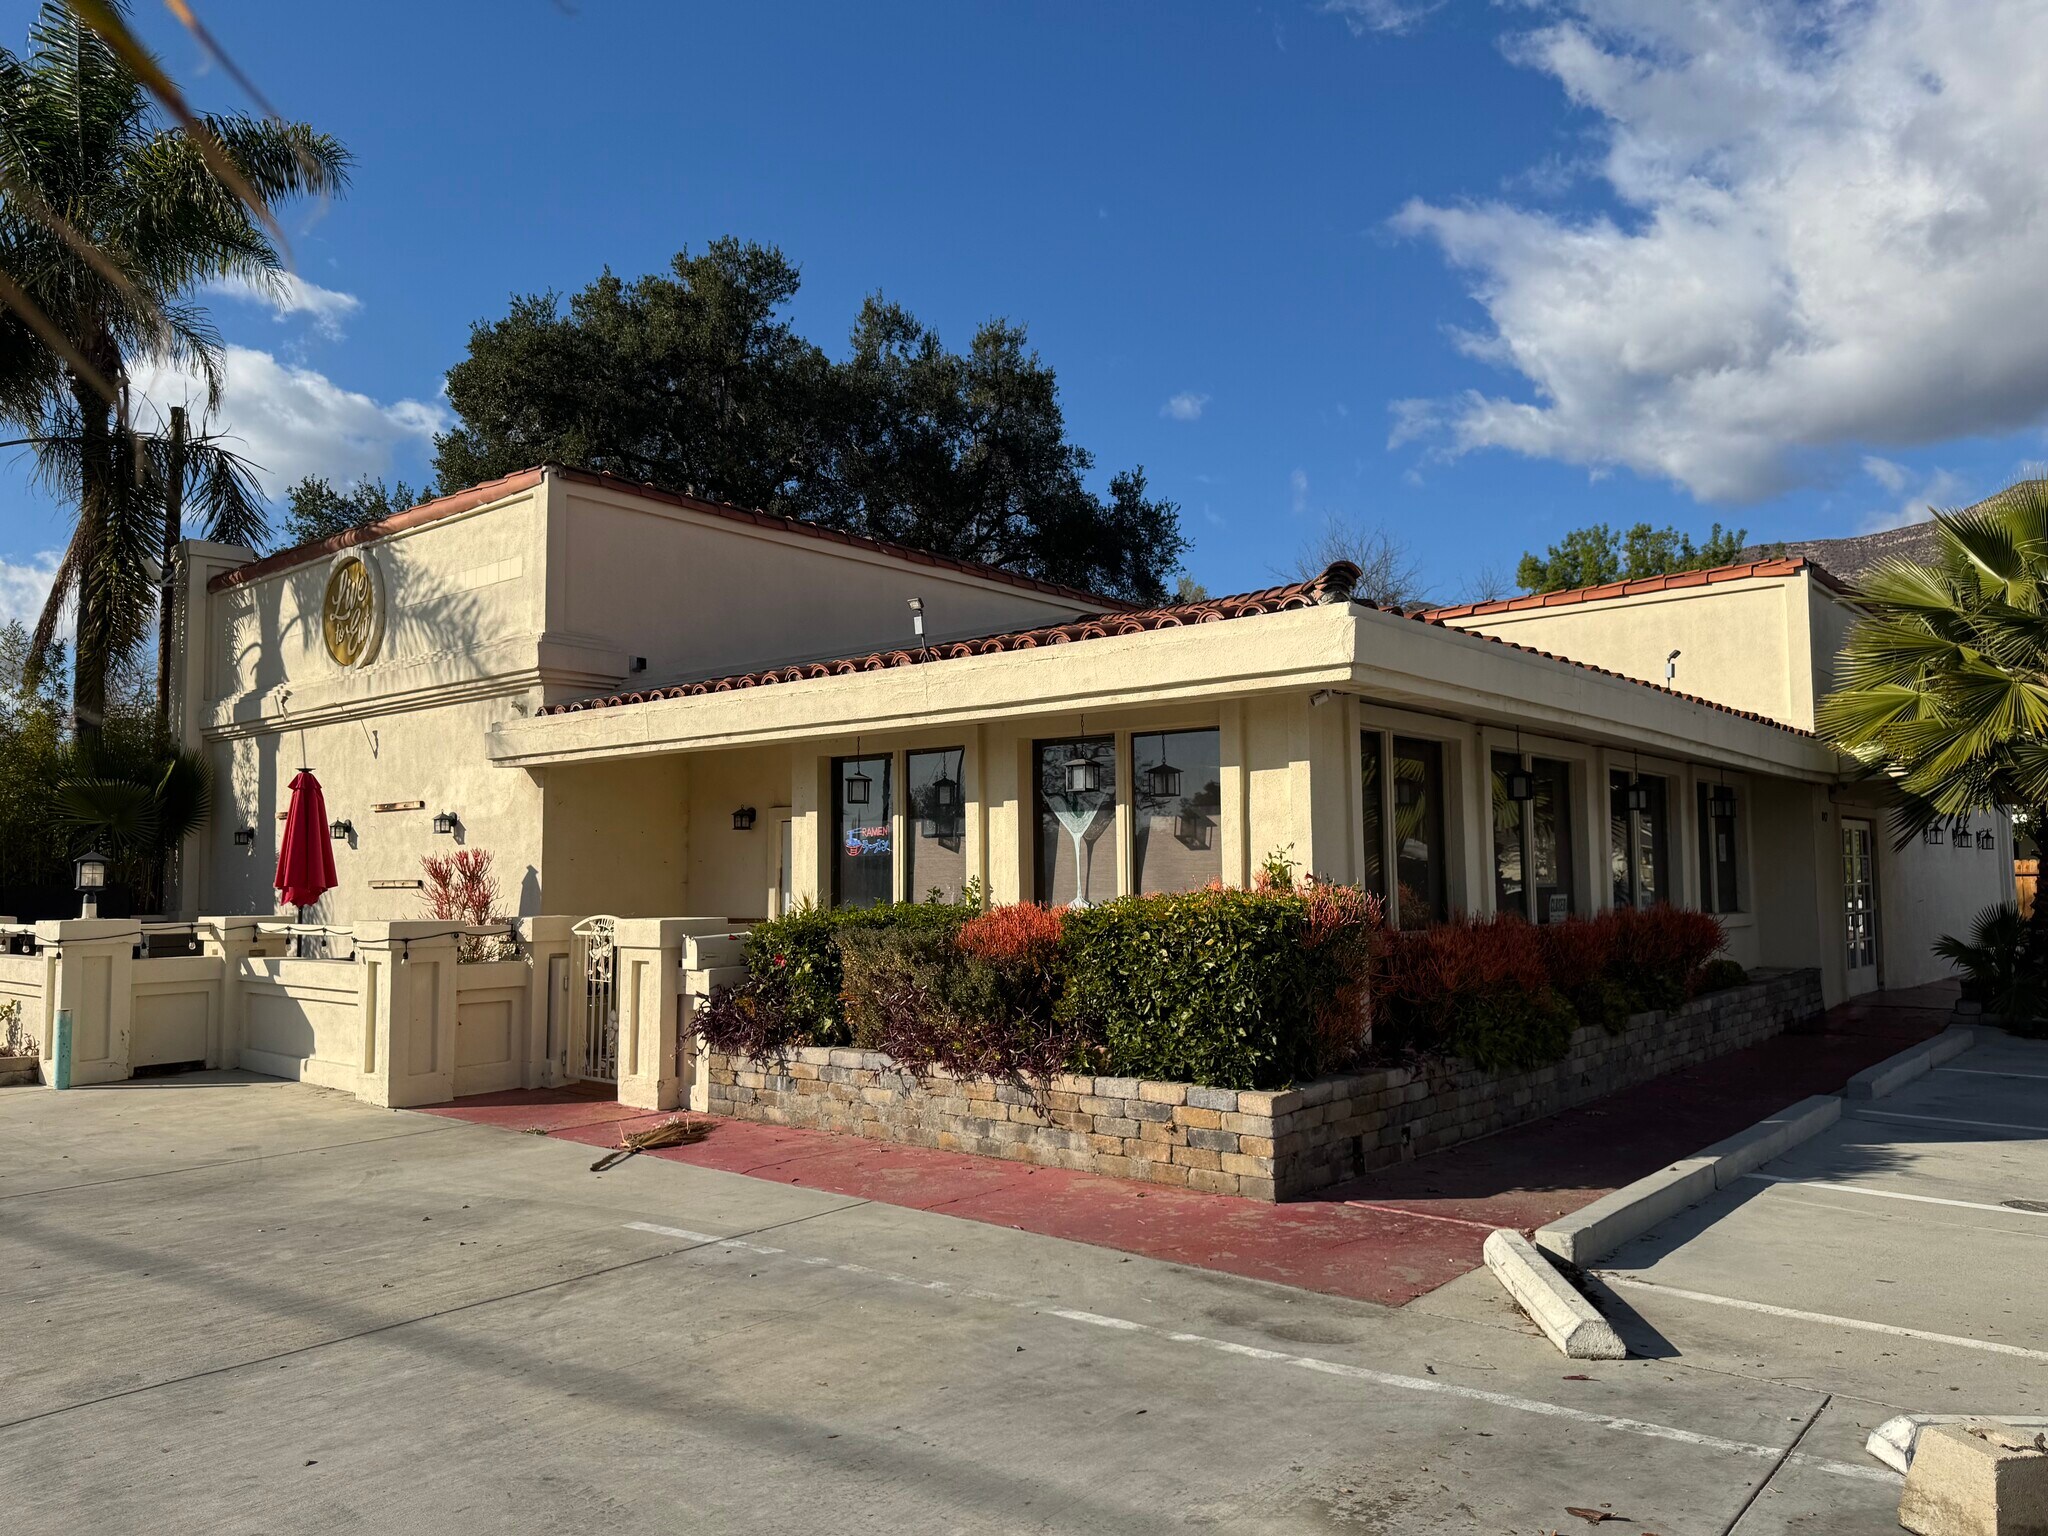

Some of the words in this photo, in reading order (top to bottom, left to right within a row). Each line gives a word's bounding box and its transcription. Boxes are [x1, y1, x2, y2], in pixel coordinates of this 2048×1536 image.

[330, 568, 368, 621] Live
[335, 623, 345, 645] to
[862, 826, 888, 837] RAMEN
